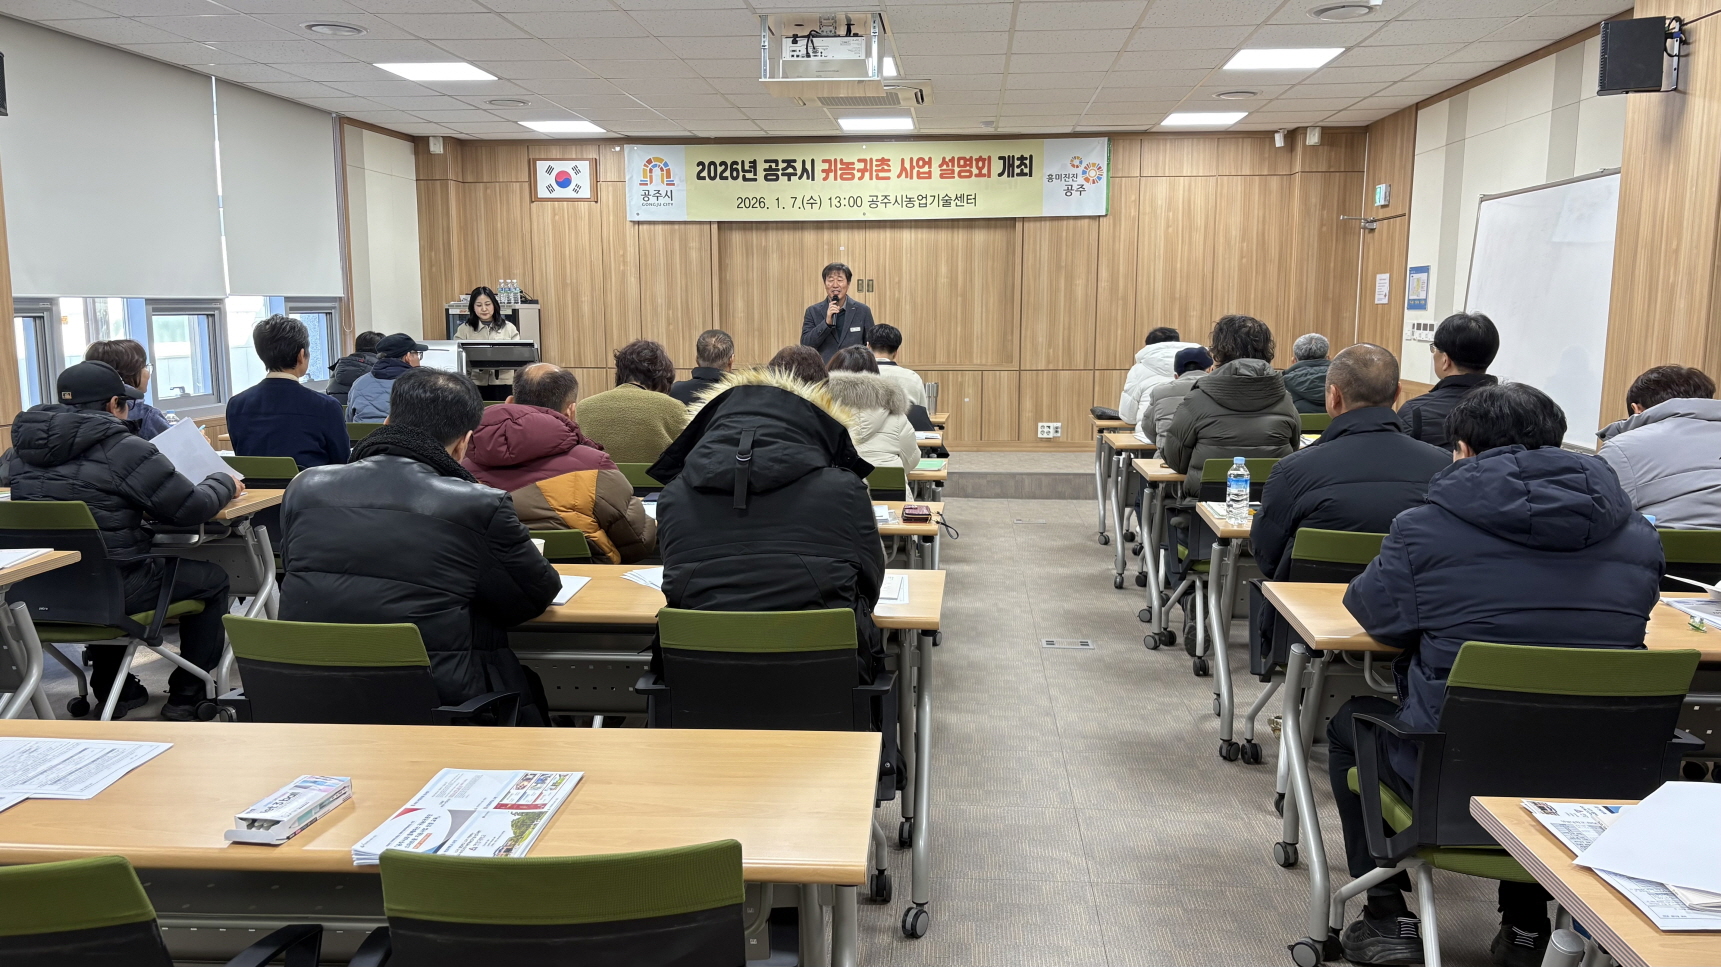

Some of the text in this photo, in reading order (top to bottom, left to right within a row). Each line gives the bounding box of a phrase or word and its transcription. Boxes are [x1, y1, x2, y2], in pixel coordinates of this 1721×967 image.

[696, 154, 1034, 182] 2026년 공주시 귀농귀촌 사업 설명회 개최
[1046, 173, 1078, 183] 흥미진진
[640, 189, 673, 202] 공주시
[1063, 184, 1087, 197] 공주
[736, 196, 770, 210] 2026.
[775, 196, 786, 210] 1.
[827, 195, 863, 209] 13:00
[867, 193, 978, 209] 공주시농업기술센터
